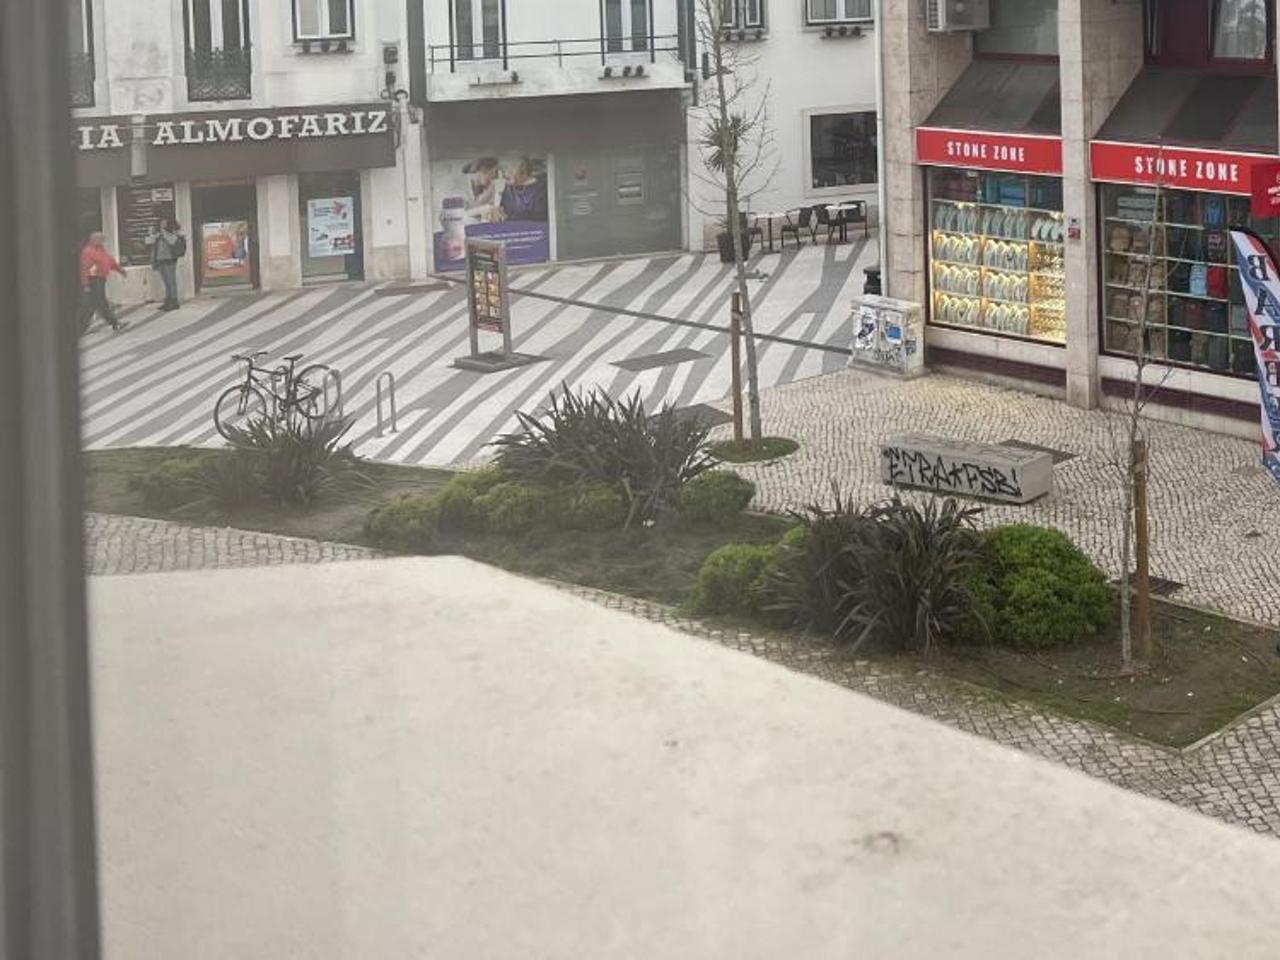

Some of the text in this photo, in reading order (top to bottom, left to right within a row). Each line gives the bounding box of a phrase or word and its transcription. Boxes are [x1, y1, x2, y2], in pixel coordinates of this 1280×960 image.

[152, 111, 387, 145] ALMOFARIZ
[947, 141, 1025, 162] STONE ZONE
[1134, 155, 1239, 182] STONE ZONE
